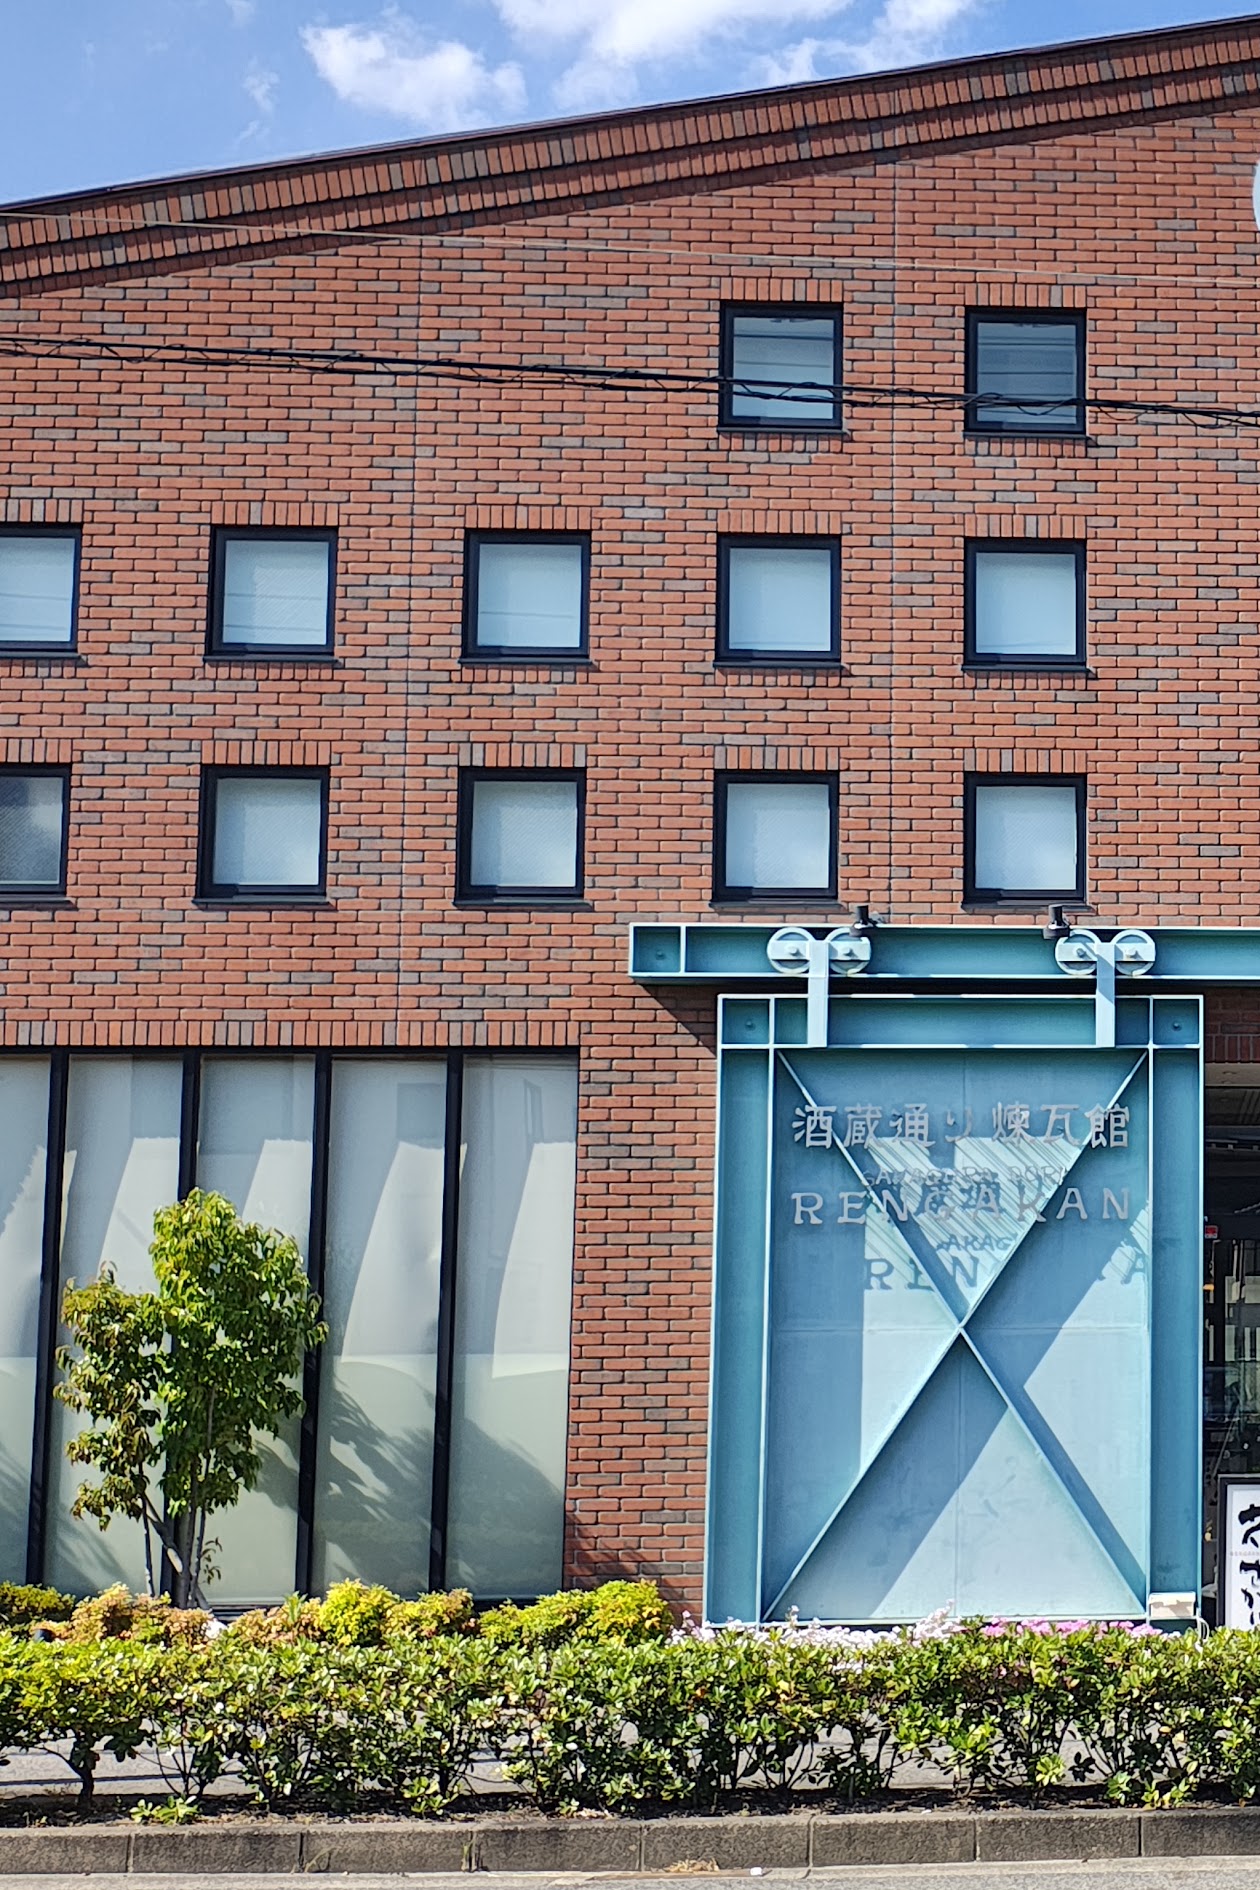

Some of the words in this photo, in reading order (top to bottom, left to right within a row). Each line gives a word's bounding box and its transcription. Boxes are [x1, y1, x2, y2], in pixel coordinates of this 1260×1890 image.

[791, 1101, 1130, 1150] 酒蔵通り煉瓦館
[791, 1187, 1130, 1226] RENGAKAN
